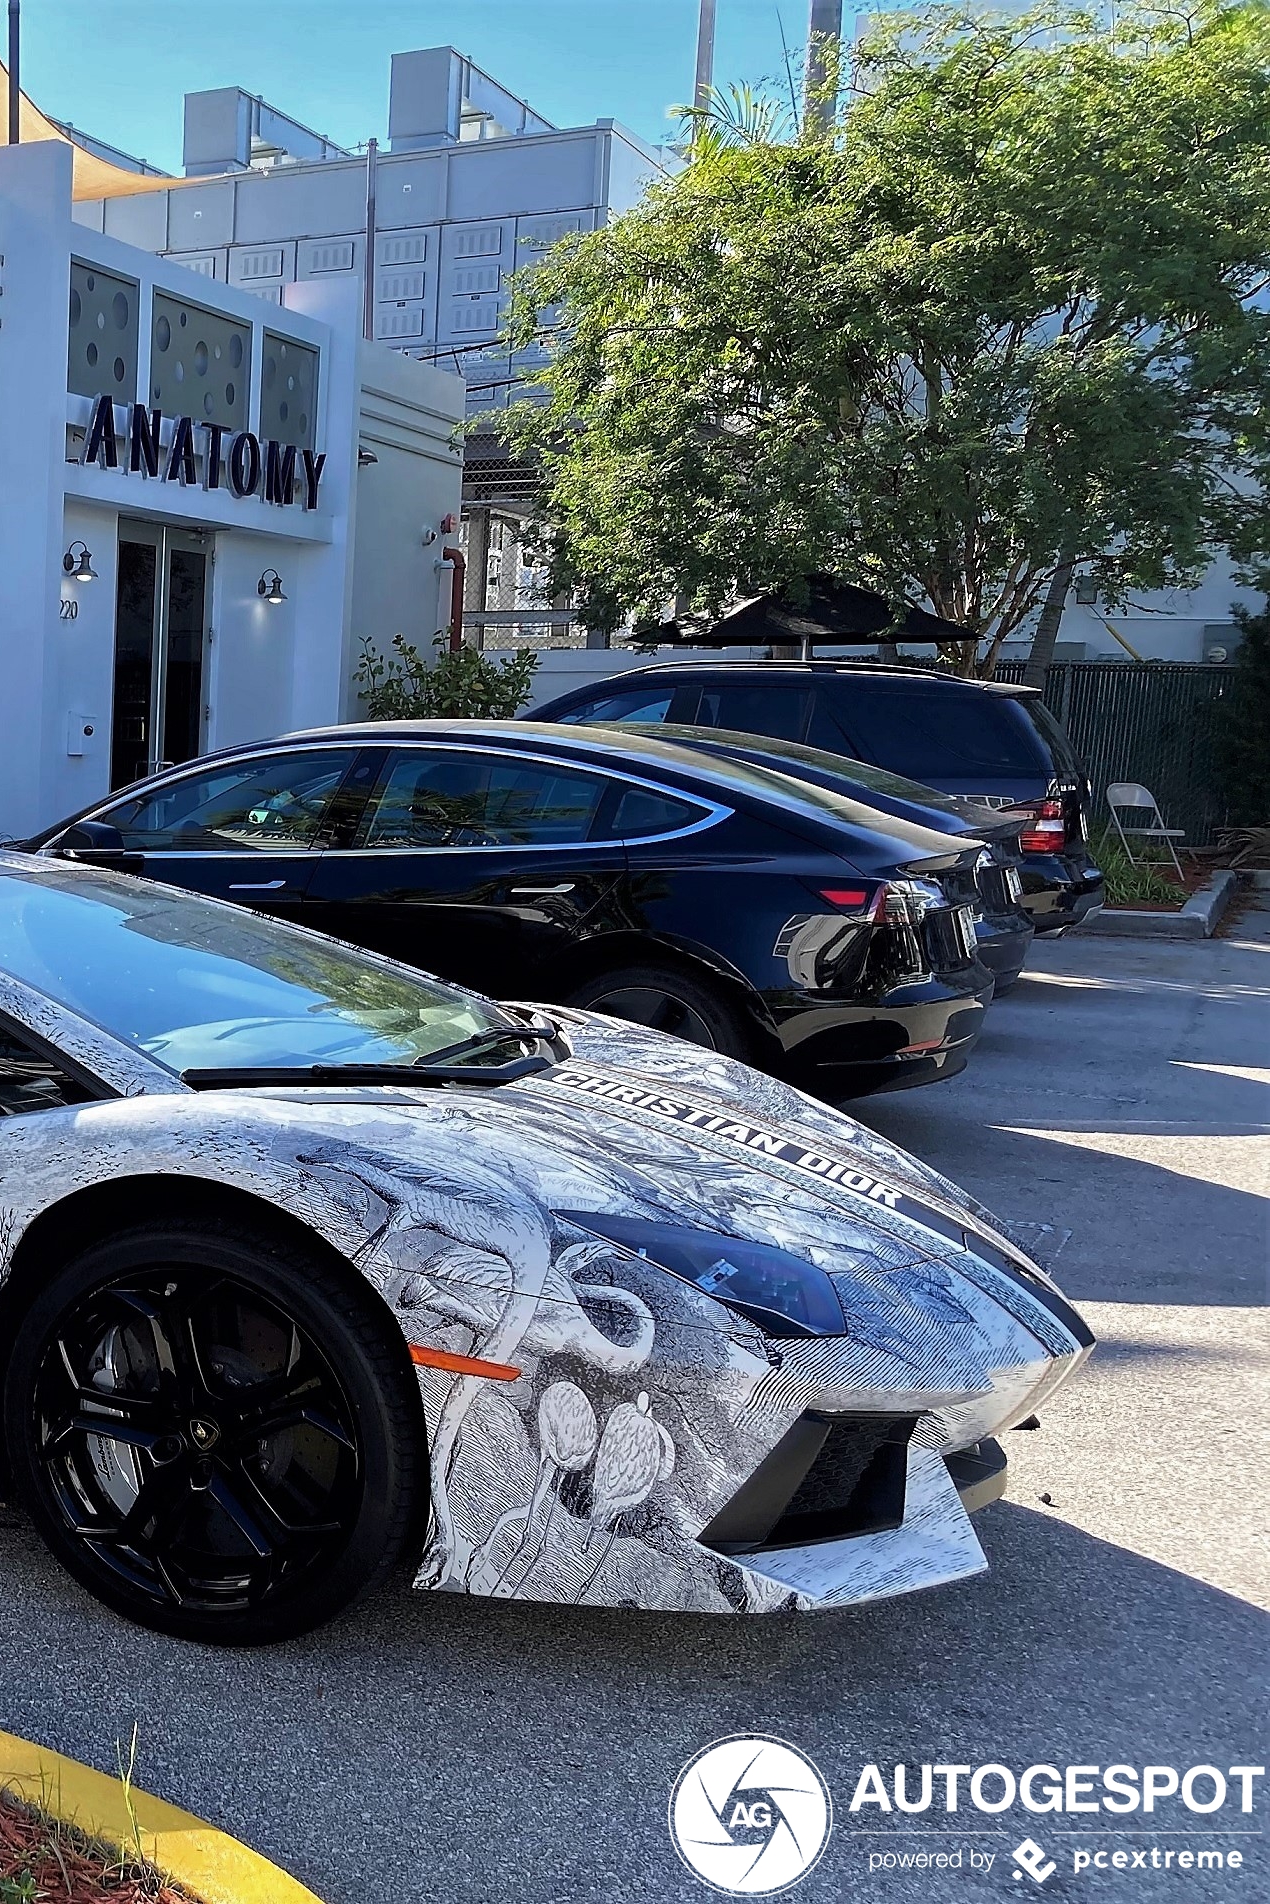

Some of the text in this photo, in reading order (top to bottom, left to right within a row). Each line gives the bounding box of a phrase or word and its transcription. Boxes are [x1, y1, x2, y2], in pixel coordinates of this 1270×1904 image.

[84, 394, 326, 510] ANATOMY
[550, 1070, 903, 1208] CHRISTIAN DIOR
